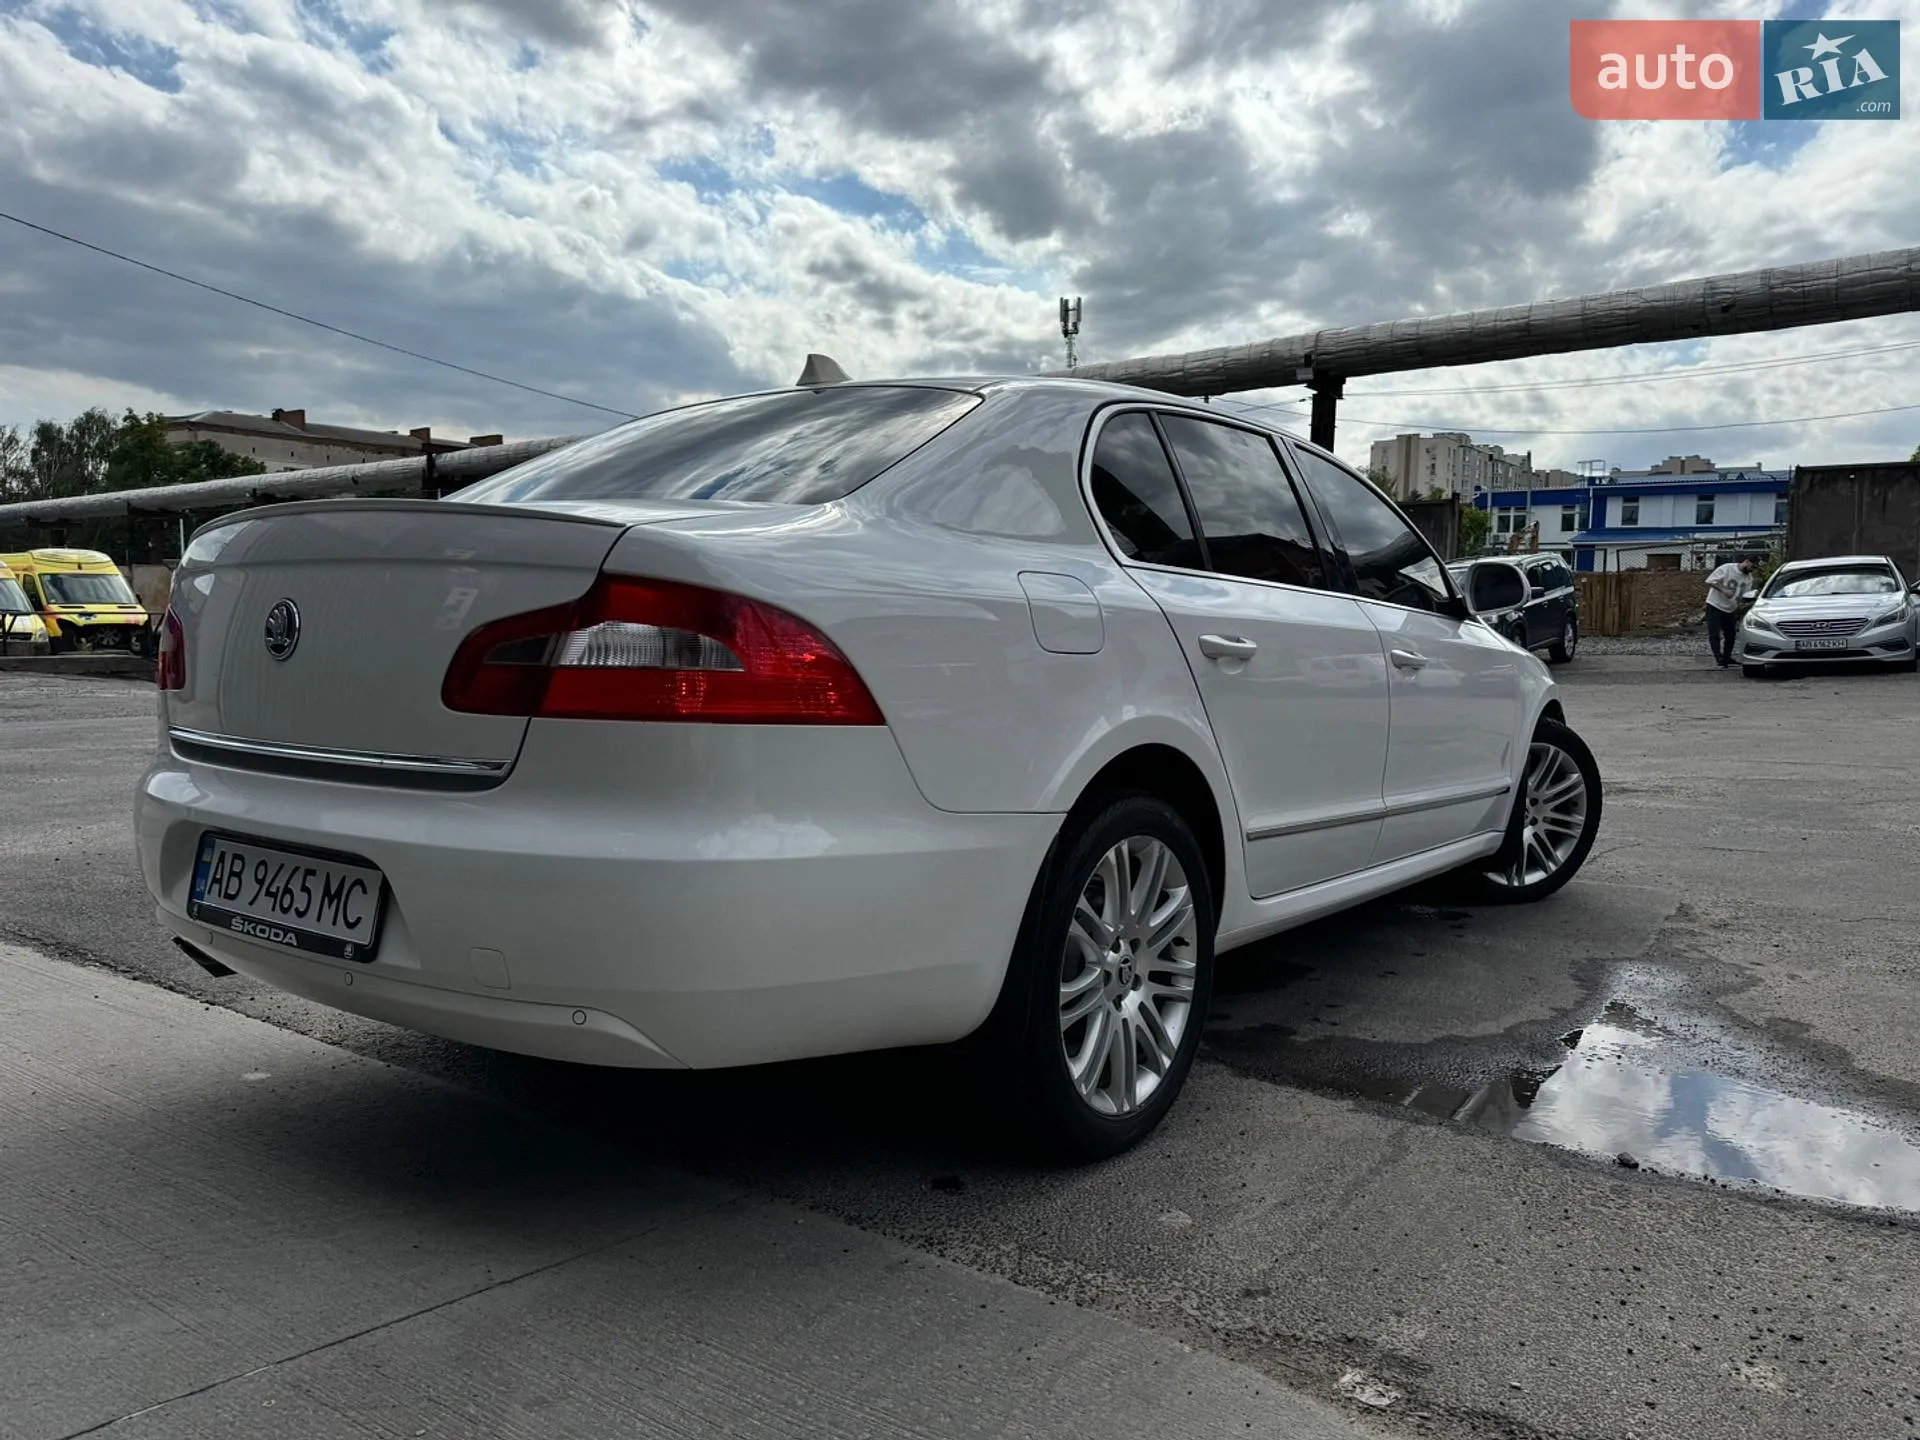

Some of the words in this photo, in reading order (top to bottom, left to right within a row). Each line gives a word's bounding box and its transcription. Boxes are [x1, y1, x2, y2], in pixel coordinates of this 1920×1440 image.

[207, 851, 246, 900] AB
[248, 859, 317, 919] 9465
[316, 872, 368, 930] MC
